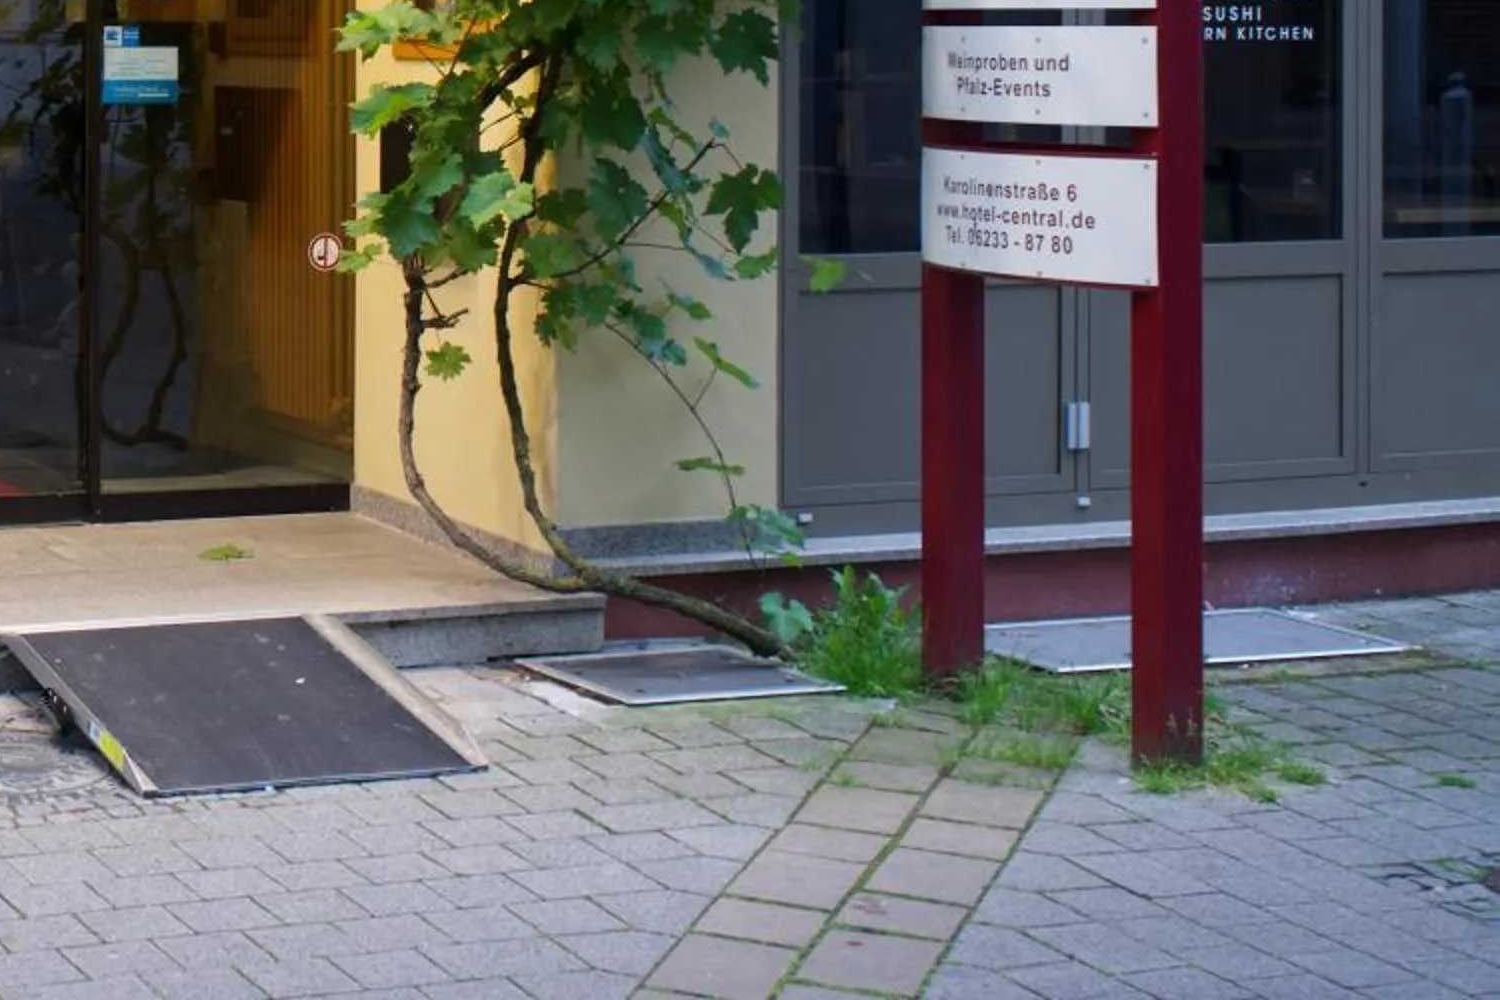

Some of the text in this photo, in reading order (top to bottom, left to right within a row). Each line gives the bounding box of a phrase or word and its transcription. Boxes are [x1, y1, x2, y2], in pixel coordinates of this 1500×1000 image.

[1203, 6, 1262, 21] SUSHI
[1237, 27, 1314, 41] KITCHEN
[948, 53, 1070, 74] Weinproben und
[957, 77, 1052, 98] Pfalz-Events
[943, 176, 1078, 203] Karolinenstraße 6
[937, 203, 1096, 230] www.hotel-central.de
[945, 225, 966, 245] Tel.
[967, 228, 1009, 249] 06233
[1024, 234, 1044, 252] 87
[1051, 236, 1074, 254] 80
